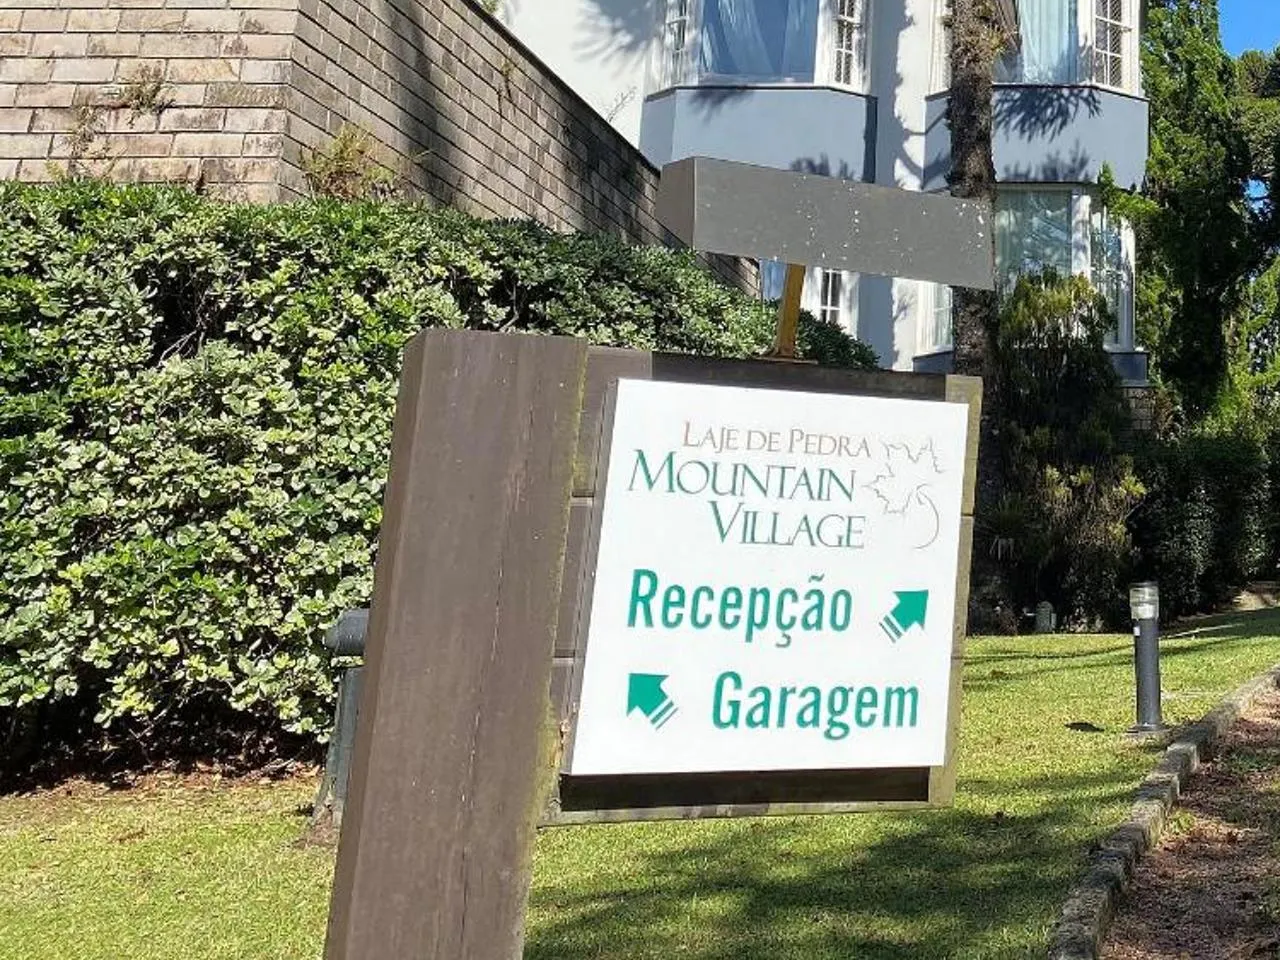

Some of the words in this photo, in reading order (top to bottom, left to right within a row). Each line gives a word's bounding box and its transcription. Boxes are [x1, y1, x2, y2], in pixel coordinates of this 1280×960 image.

[628, 449, 856, 502] MOUNTAIN
[707, 500, 867, 549] VILLAGE
[626, 568, 853, 648] Recepção
[712, 671, 919, 740] Garagem
